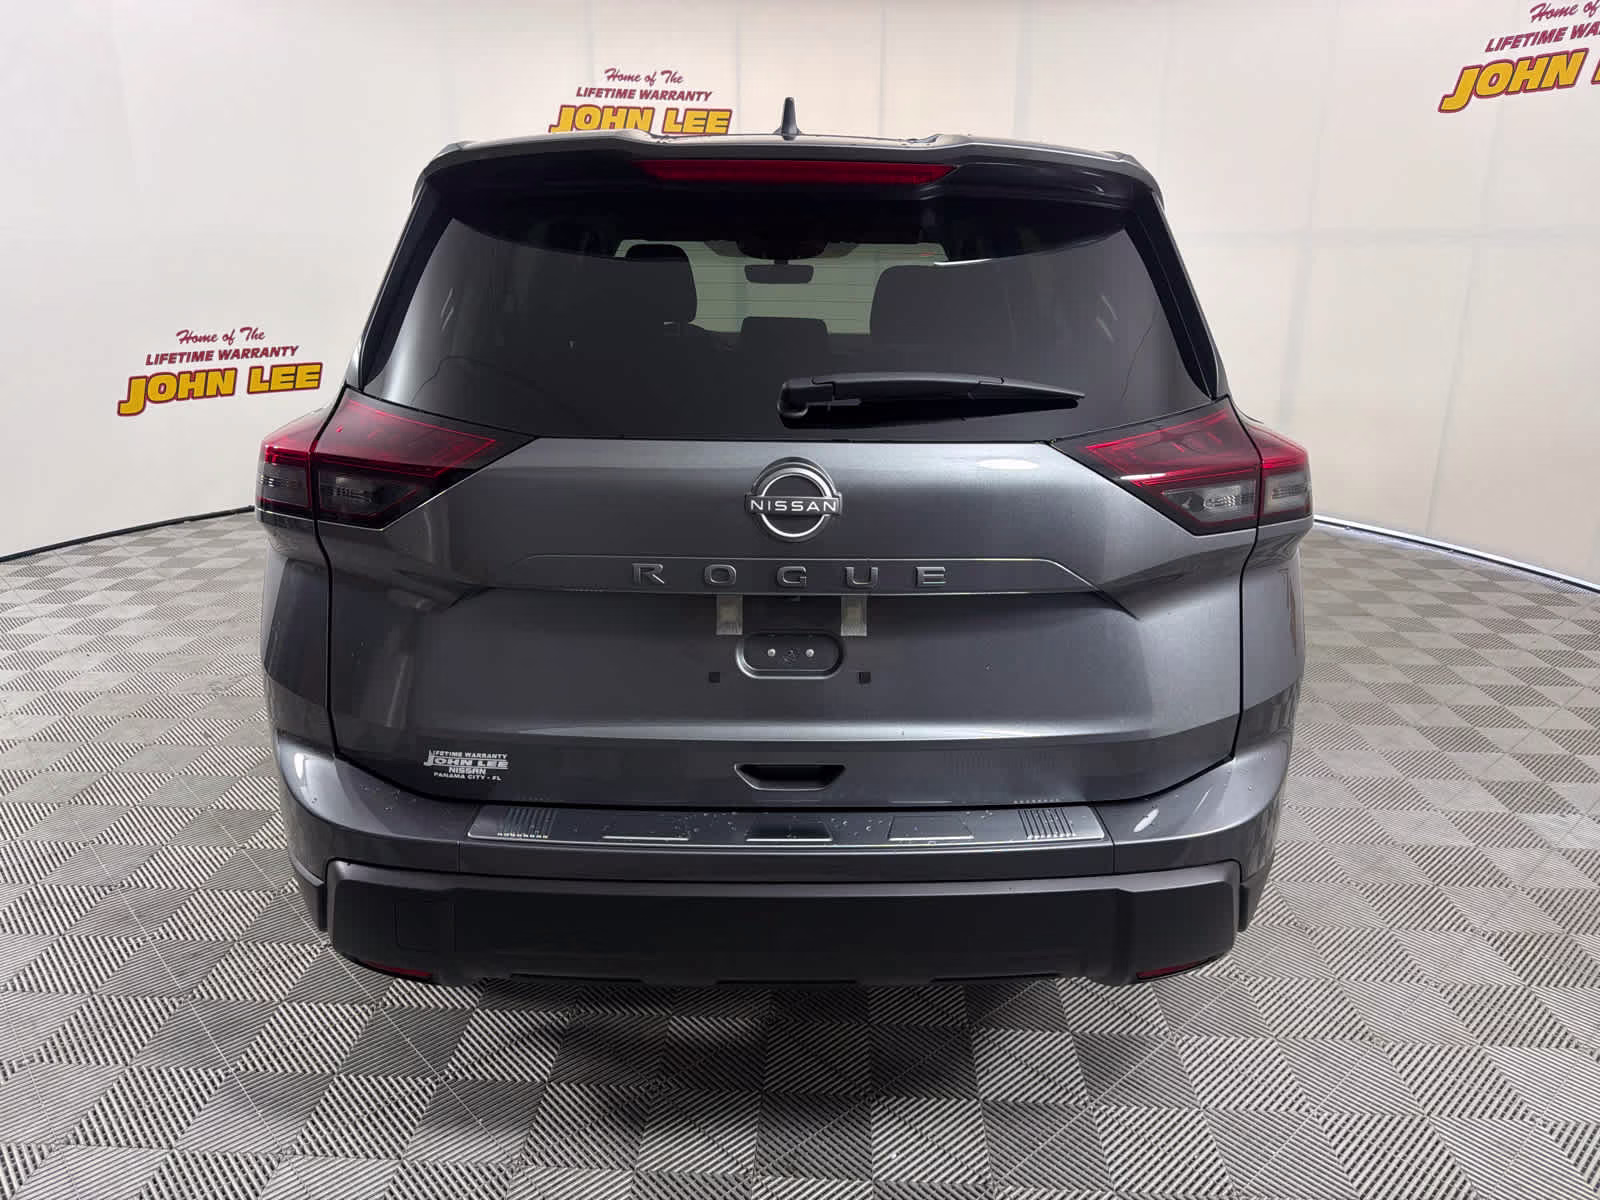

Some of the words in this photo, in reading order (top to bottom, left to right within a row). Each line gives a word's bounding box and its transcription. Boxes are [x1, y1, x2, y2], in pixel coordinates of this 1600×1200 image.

[1529, 2, 1578, 23] Home
[1583, 0, 1600, 18] of
[1485, 26, 1568, 52] LIFETIME
[1570, 21, 1600, 40] WA
[604, 67, 641, 83] Home
[644, 71, 657, 86] of
[660, 70, 684, 84] The
[1438, 48, 1589, 113] JOHN
[576, 87, 636, 99] LIFETIME
[639, 89, 712, 102] WARRANTY
[548, 104, 655, 133] JOHN
[661, 107, 733, 135] LEE
[176, 329, 218, 345] Home
[222, 329, 235, 346] of
[239, 326, 266, 342] The
[145, 349, 213, 366] LIFETIME
[217, 345, 299, 361] WARRANTY
[117, 367, 238, 417] JOHN
[247, 362, 323, 394] LEE
[750, 499, 837, 512] NISSAN
[632, 563, 947, 587] ROGUE
[424, 754, 473, 767] JOHN
[477, 759, 509, 769] LEE
[448, 767, 487, 775] NISSAN
